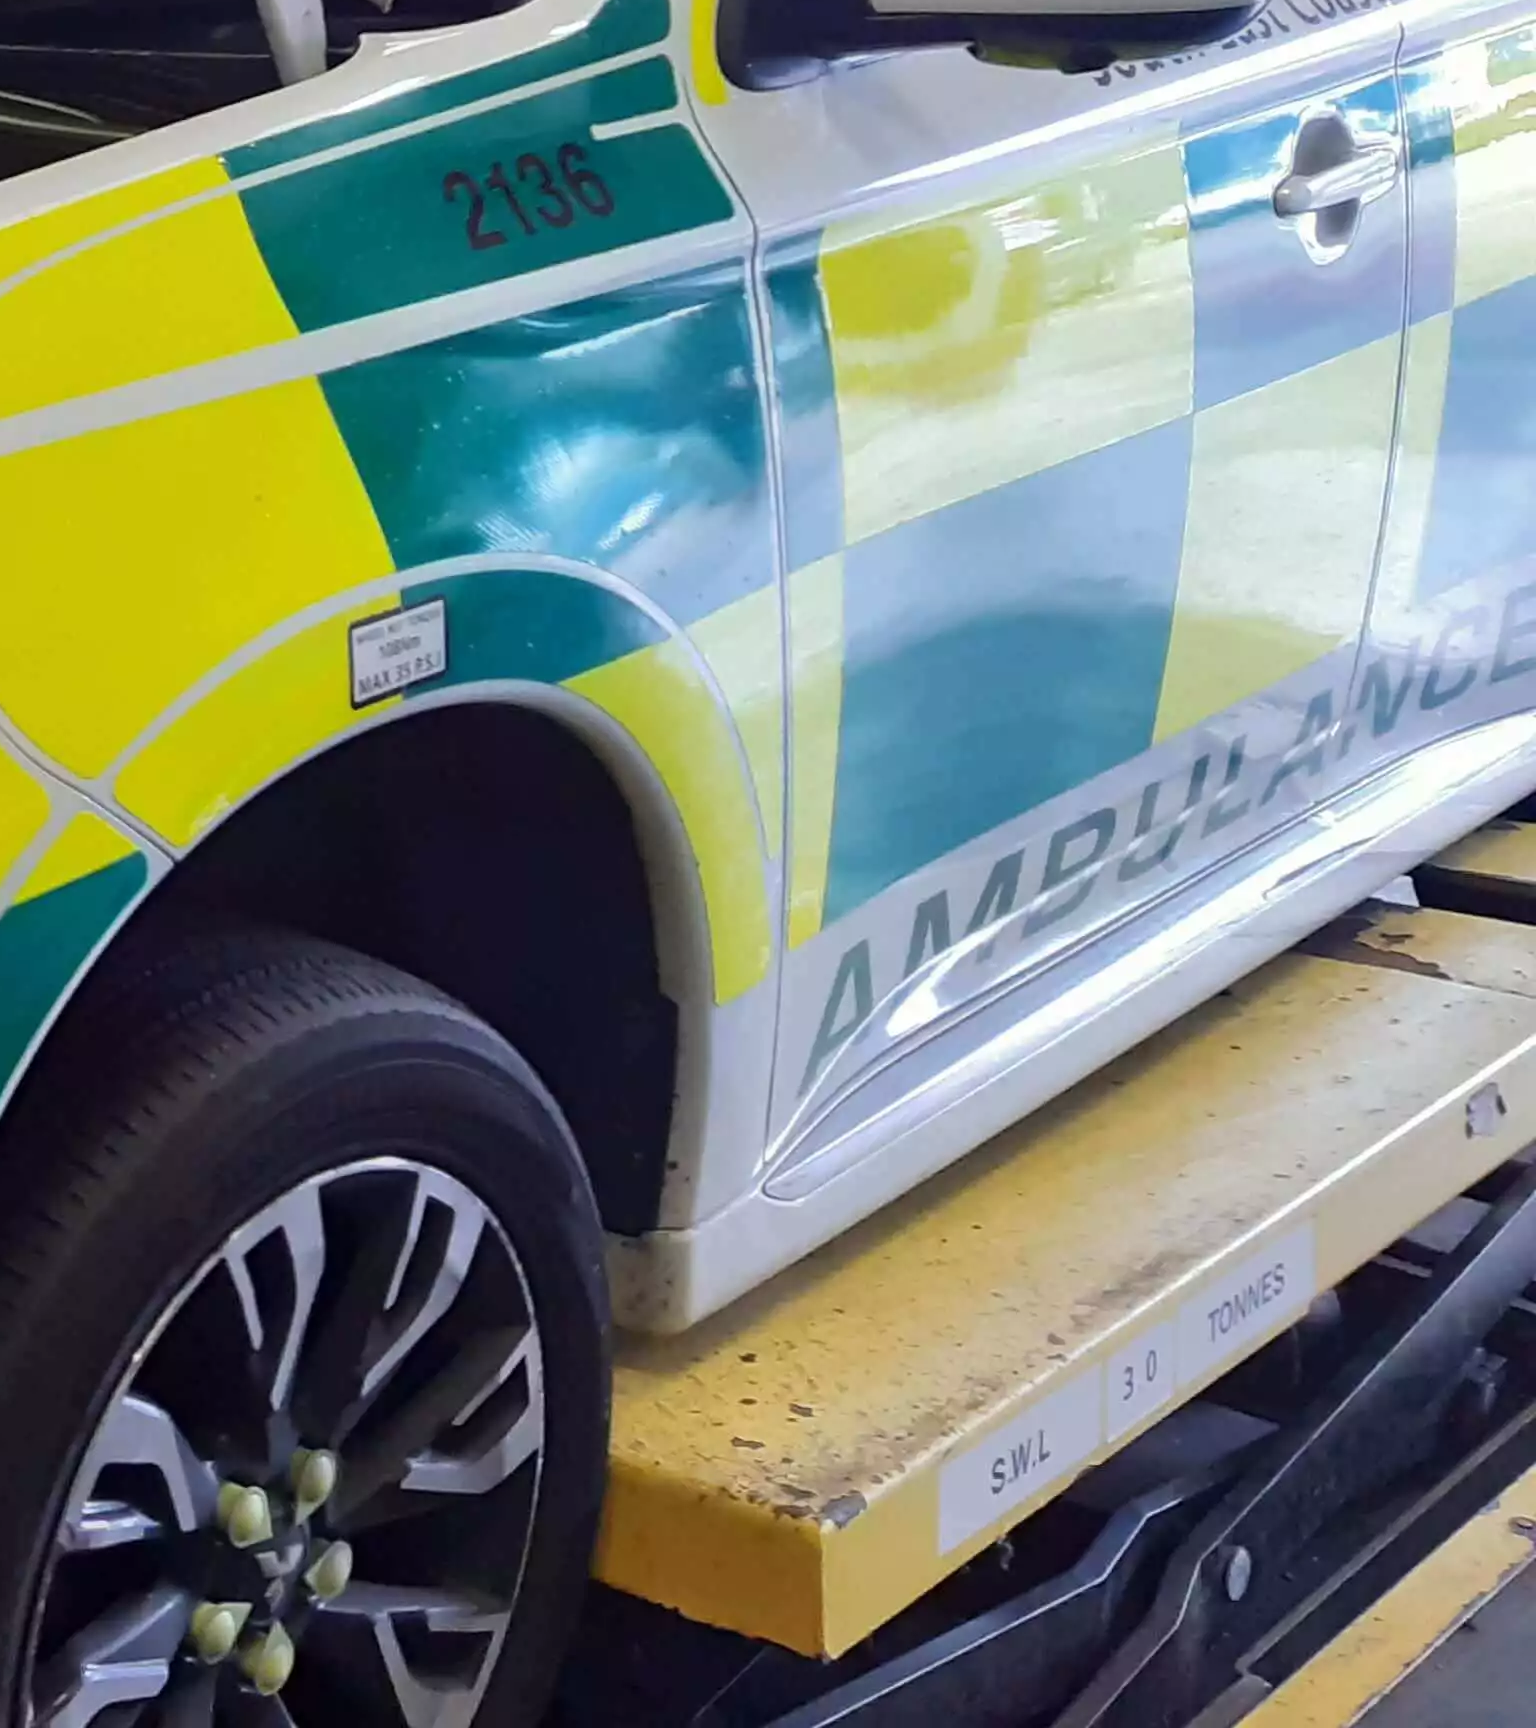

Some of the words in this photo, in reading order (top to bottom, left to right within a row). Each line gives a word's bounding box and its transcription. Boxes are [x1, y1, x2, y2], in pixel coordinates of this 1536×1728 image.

[443, 141, 616, 251] 2136
[358, 671, 391, 697] MAX
[797, 584, 1536, 1094] AMBULANCE
[990, 1428, 1051, 1496] S.W.L
[1207, 1262, 1286, 1343] TONNES
